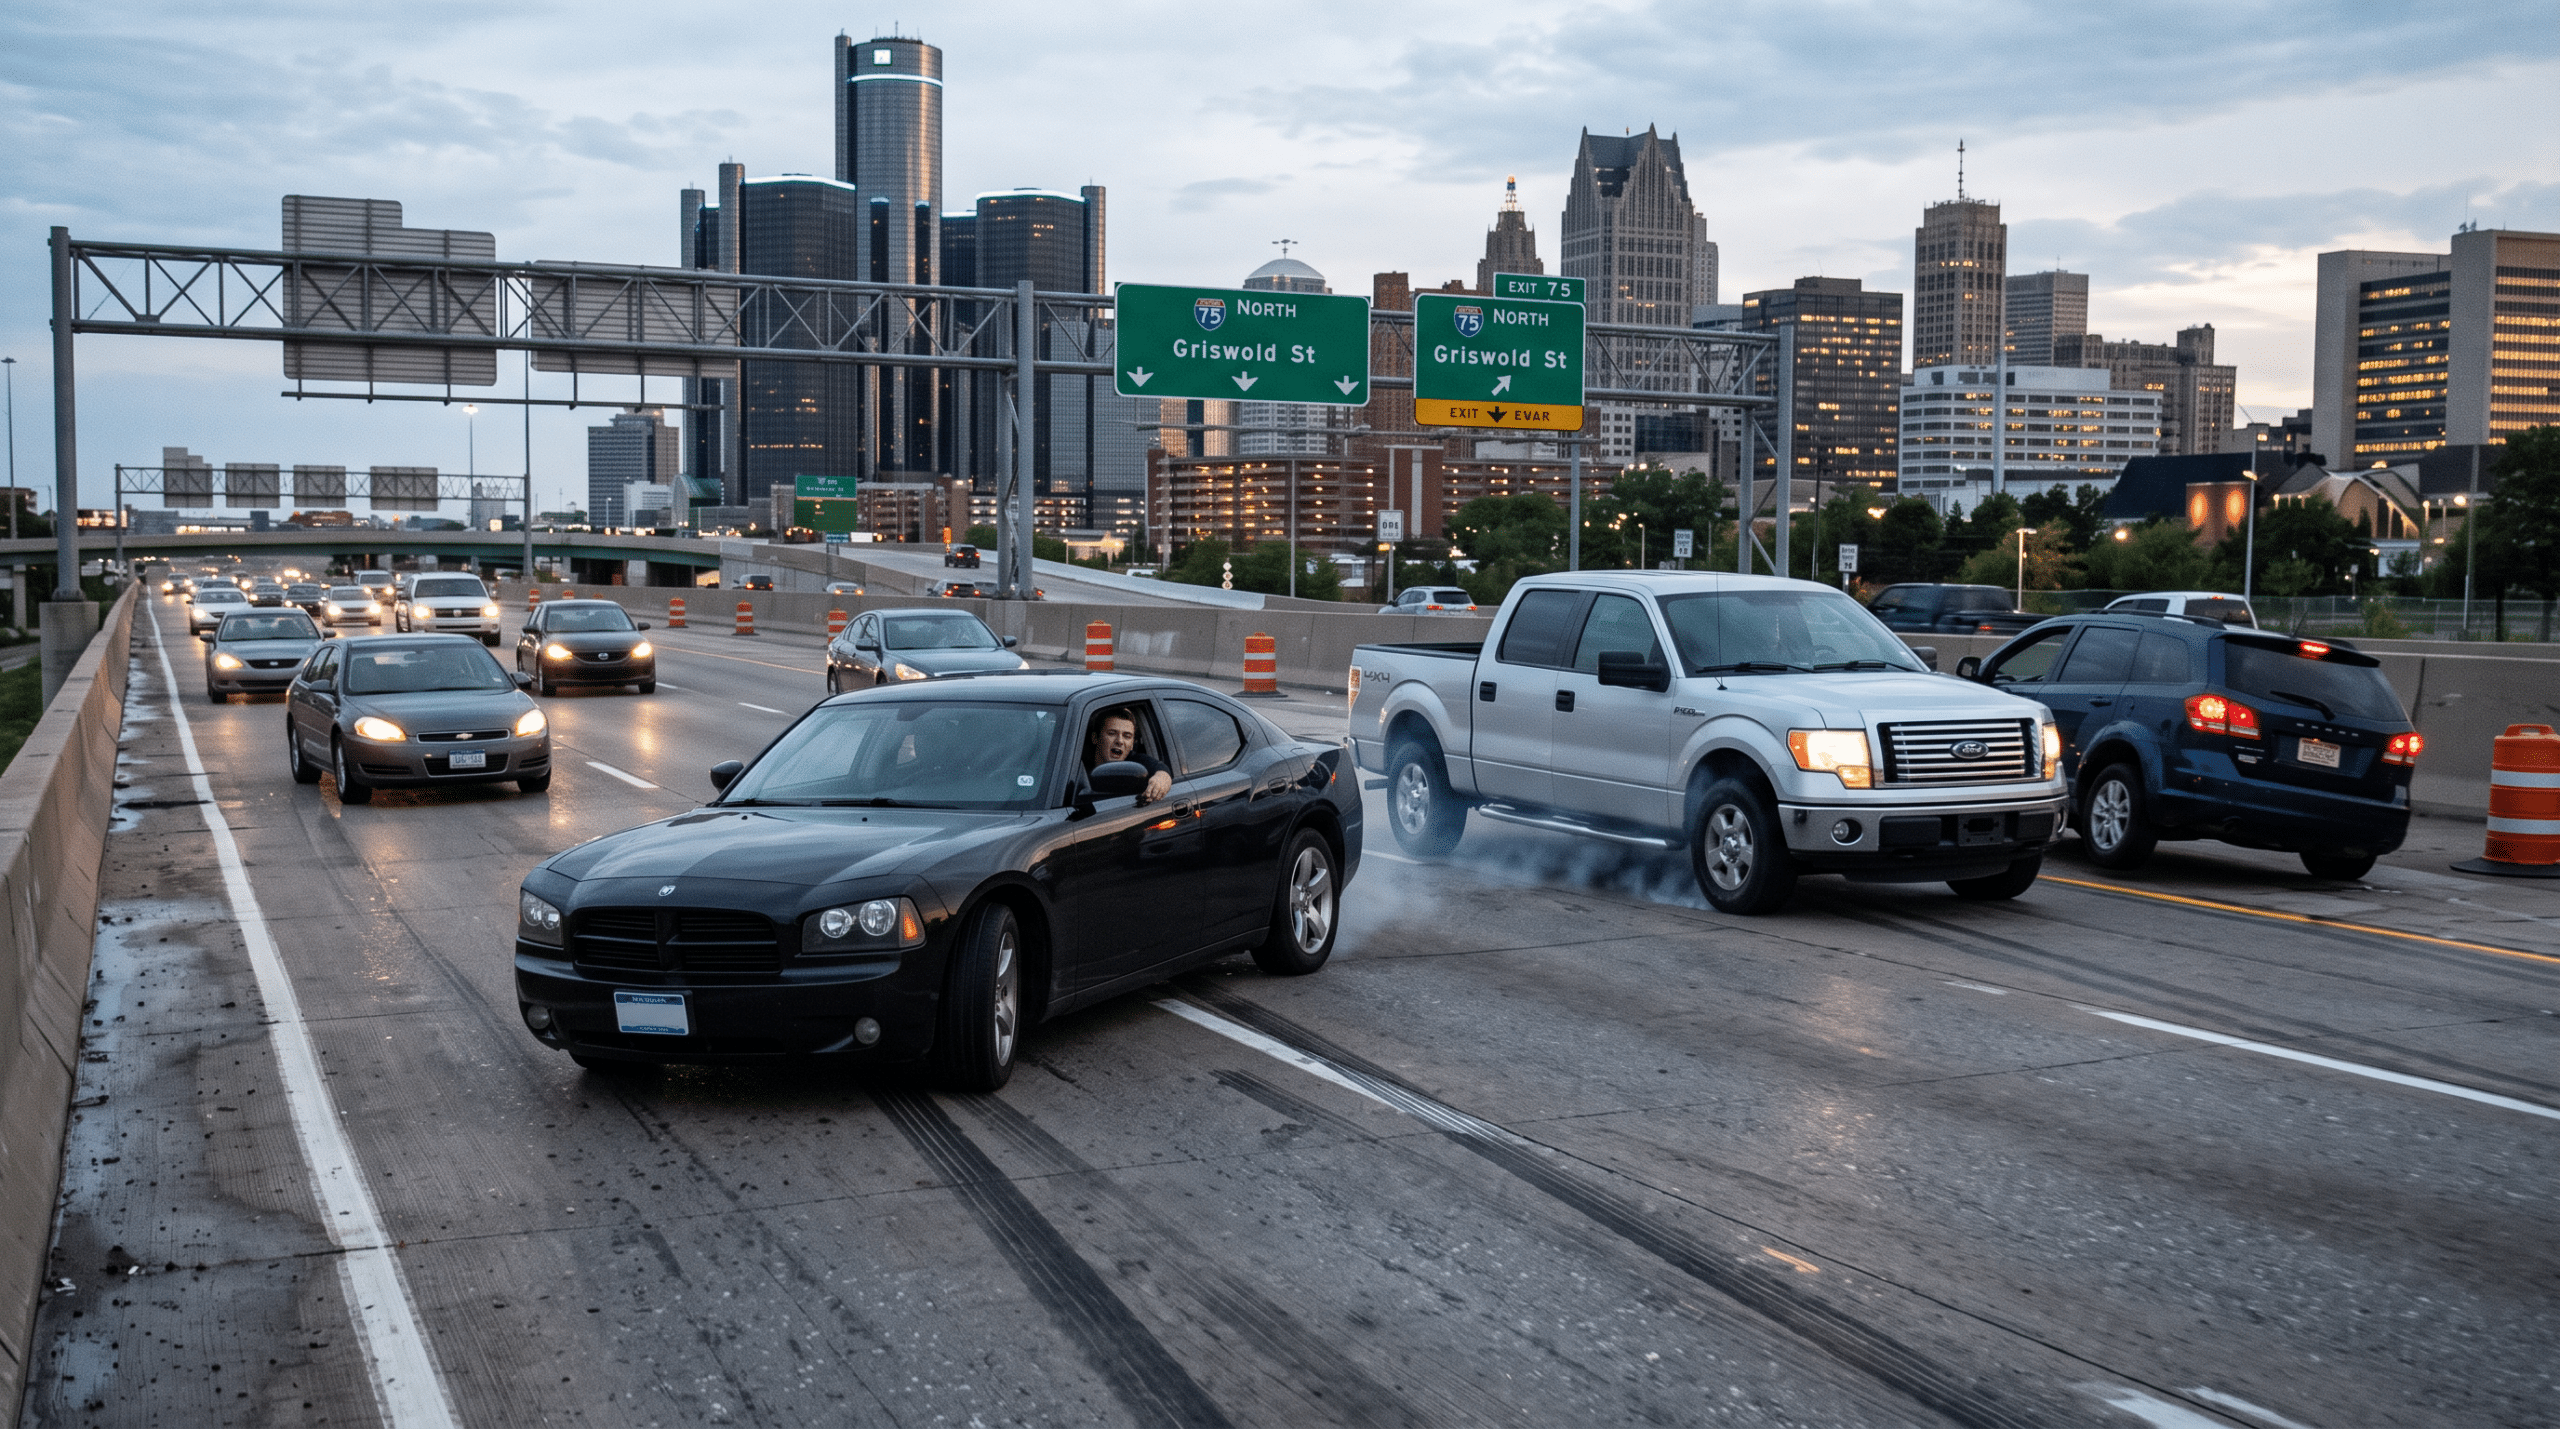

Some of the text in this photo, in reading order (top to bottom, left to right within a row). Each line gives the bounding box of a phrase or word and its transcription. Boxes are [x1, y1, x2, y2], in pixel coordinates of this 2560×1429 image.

[1509, 281, 1571, 297] EXIT 75
[1199, 308, 1221, 324] 75
[1237, 299, 1296, 317] NORTH
[1458, 315, 1479, 331] 75
[1494, 309, 1549, 326] NORTH
[1173, 339, 1315, 363] Griswold St
[1434, 345, 1567, 369] Griswold St
[1450, 408, 1478, 418] EXIT
[1515, 411, 1549, 421] EVAR
